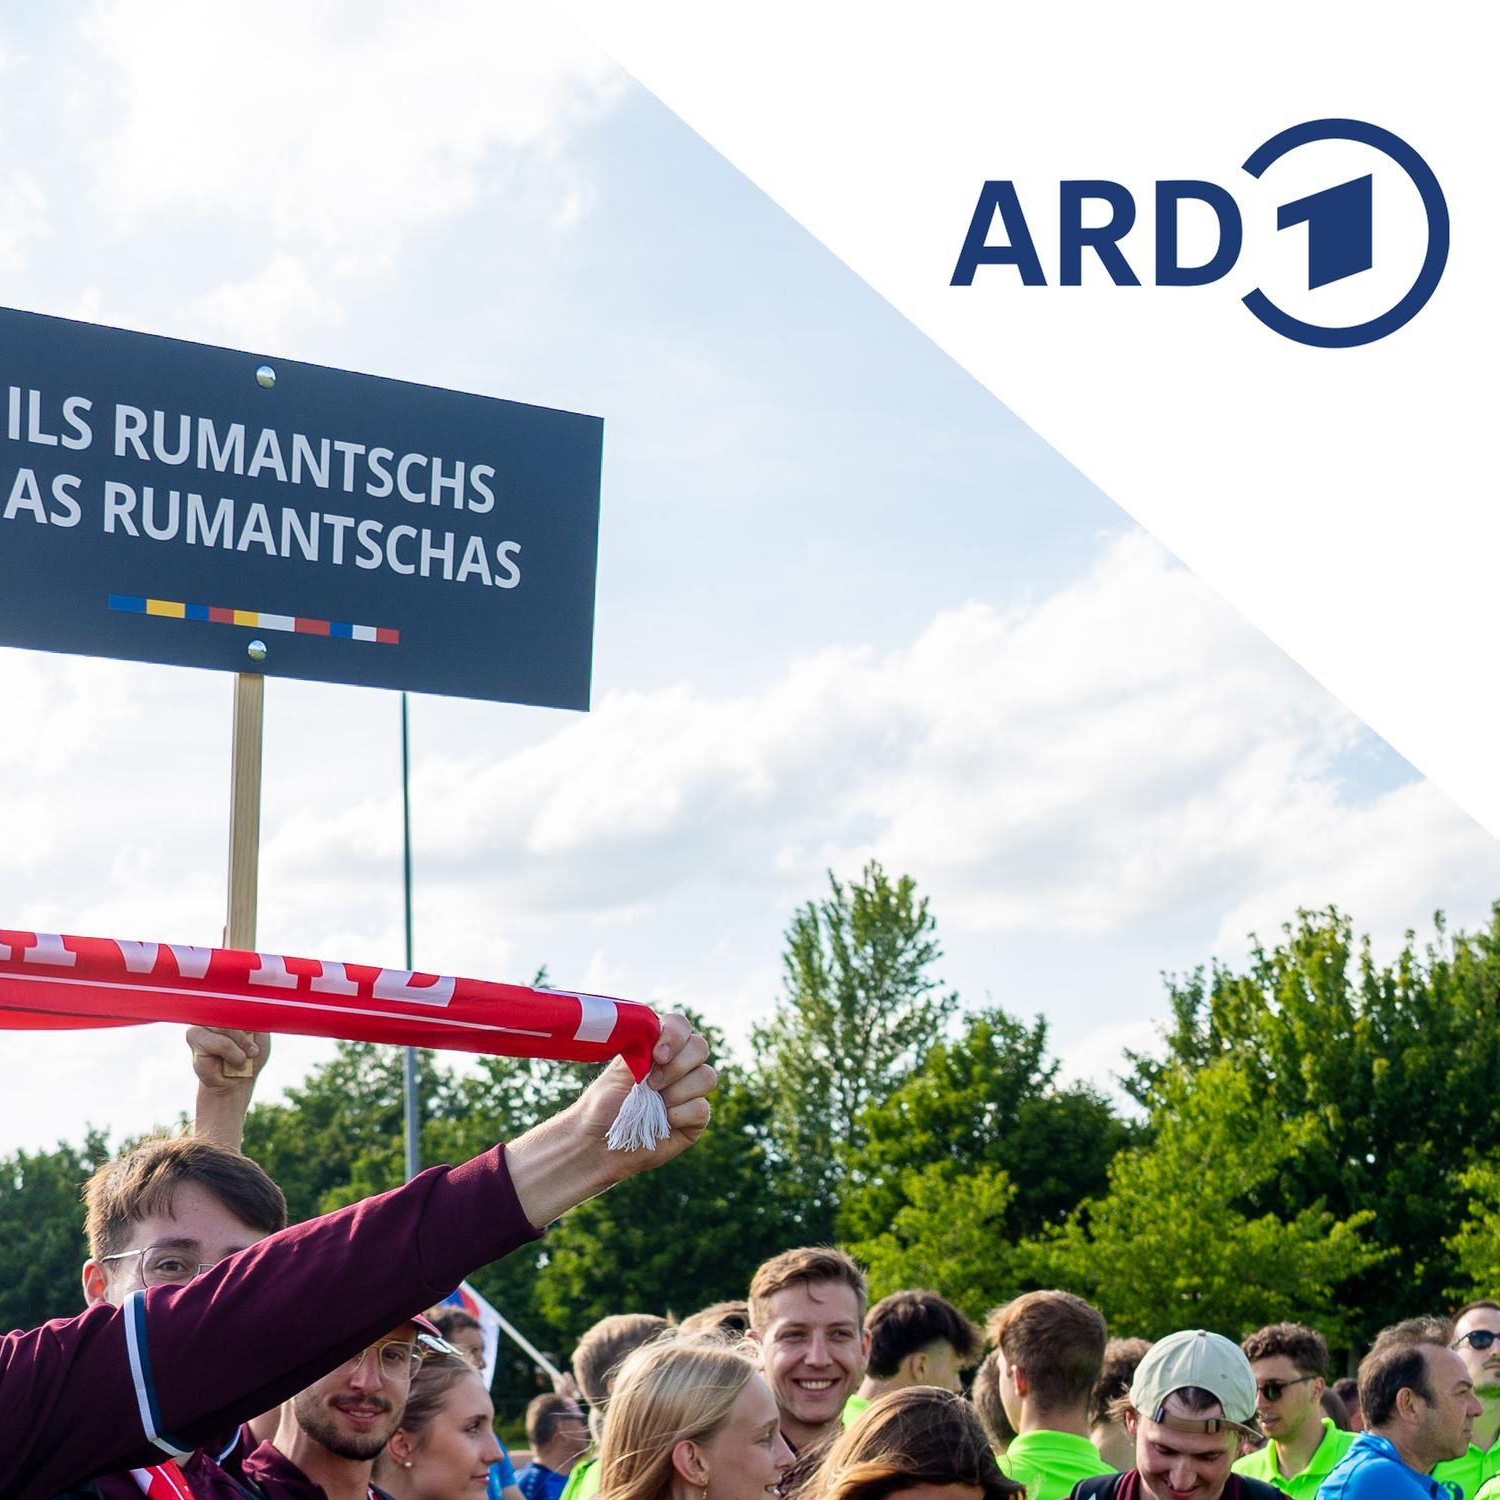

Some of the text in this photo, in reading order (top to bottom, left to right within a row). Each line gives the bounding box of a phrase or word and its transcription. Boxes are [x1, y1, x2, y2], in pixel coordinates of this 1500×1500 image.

[7, 386, 496, 514] ILS RUMANTSCHS
[102, 480, 522, 590] RUMANTSCHAS
